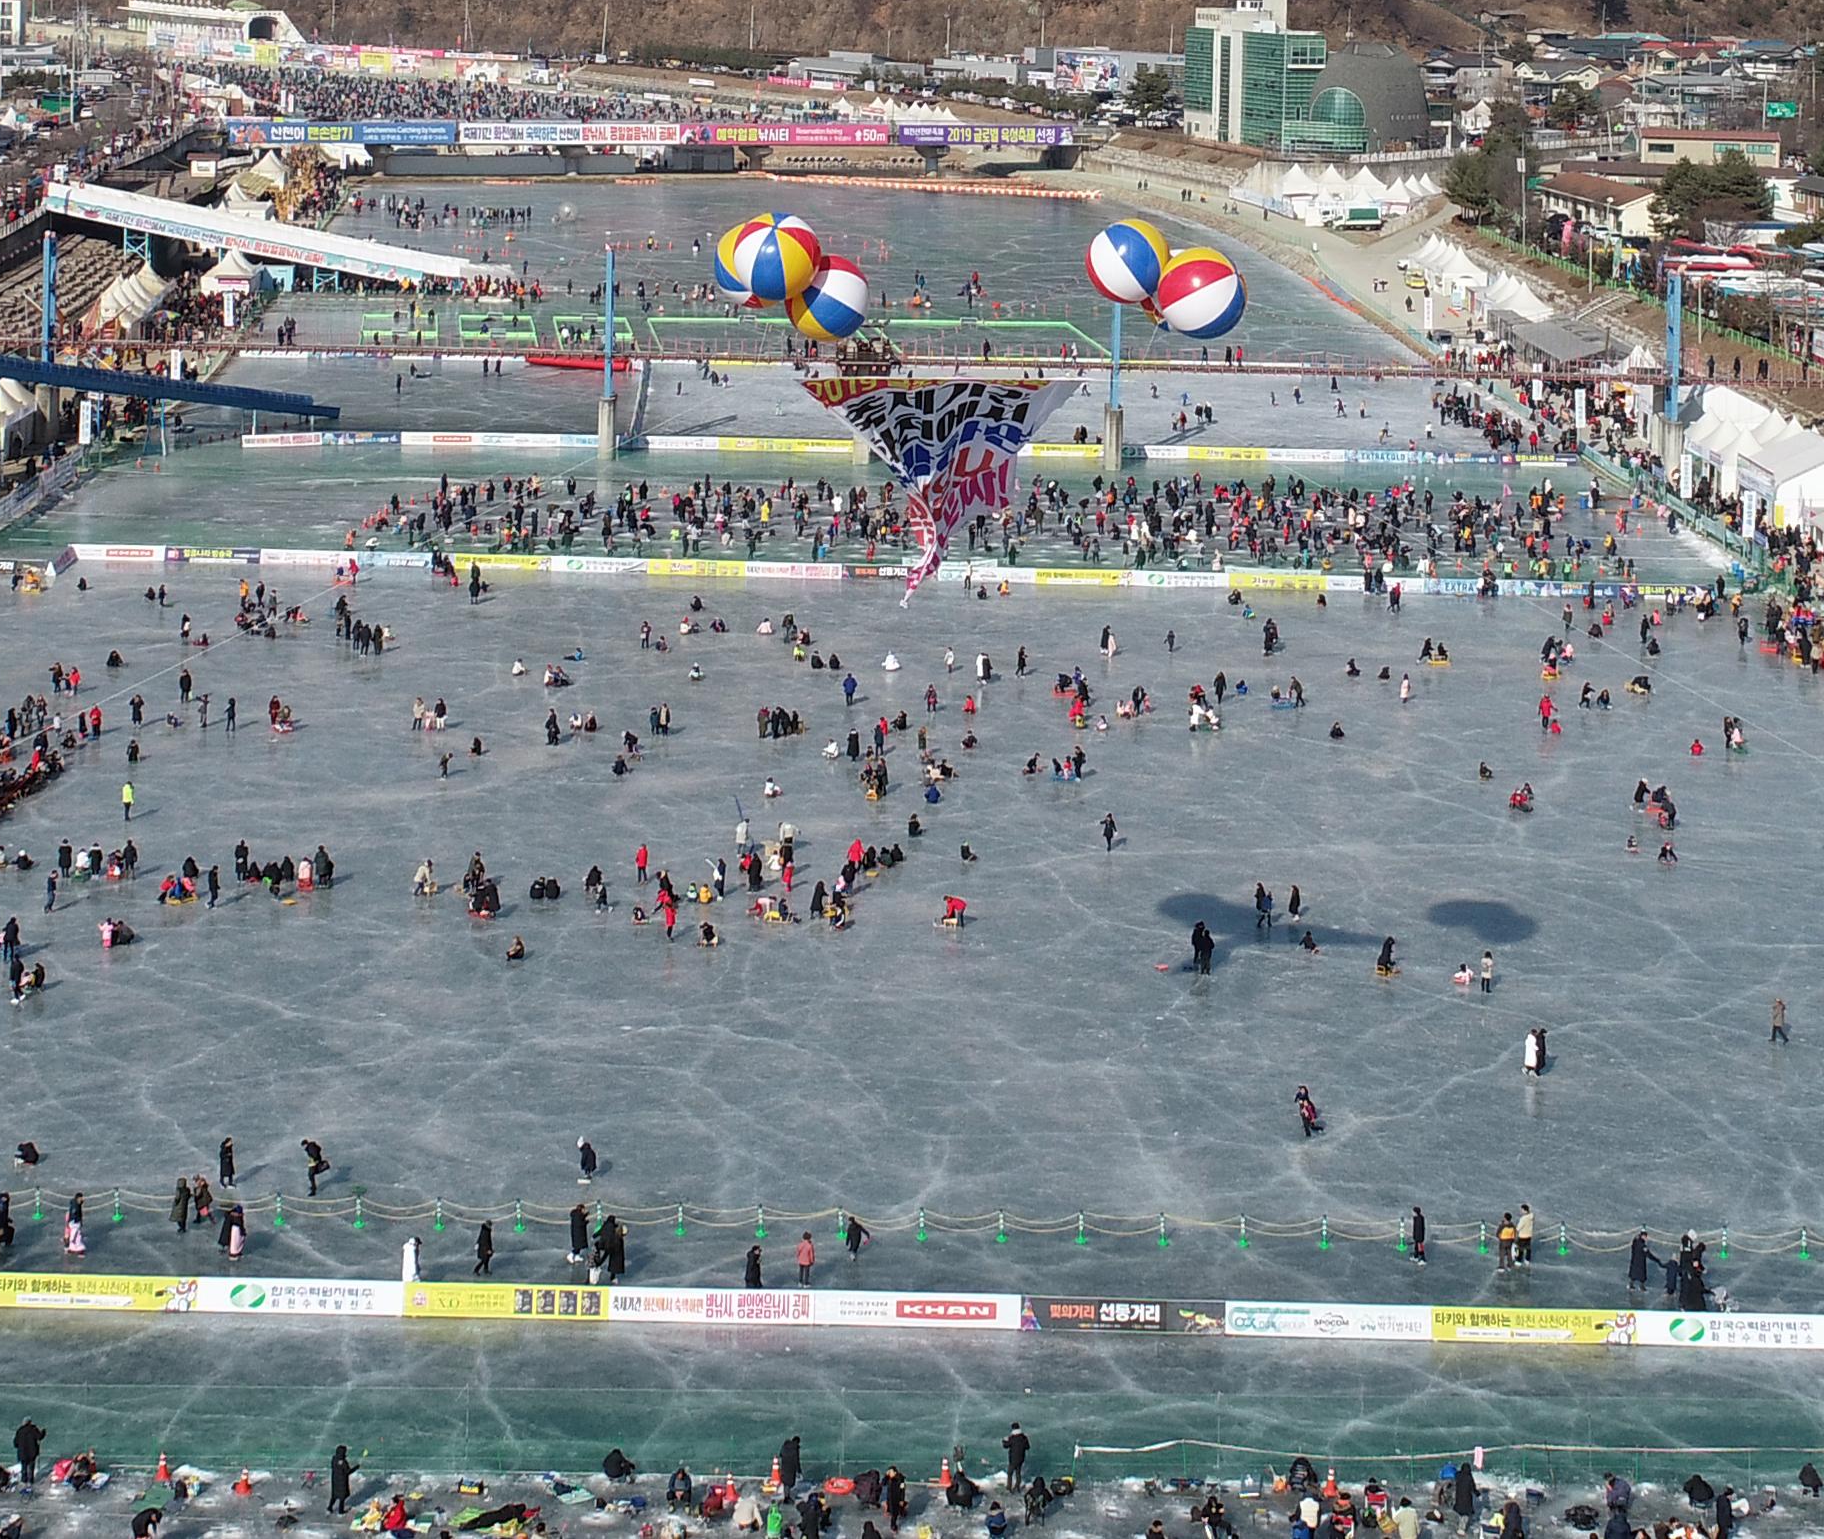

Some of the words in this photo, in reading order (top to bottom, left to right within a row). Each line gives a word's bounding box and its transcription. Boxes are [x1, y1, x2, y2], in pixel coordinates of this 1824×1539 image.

[271, 128, 304, 140] 산천어
[863, 129, 886, 141] 50m
[948, 127, 971, 142] 2019
[973, 127, 998, 142] 글로벌
[1036, 127, 1056, 142] 선정
[1445, 583, 1474, 592] EXTRA
[30, 1279, 72, 1294] 함께하는
[97, 1280, 130, 1295] 산천어
[901, 1304, 990, 1316] KHAN
[1099, 1303, 1160, 1323] 선등거리
[1435, 1313, 1467, 1327] 타키와
[1468, 1314, 1511, 1328] 함께하는
[1537, 1315, 1569, 1329] 산천어
